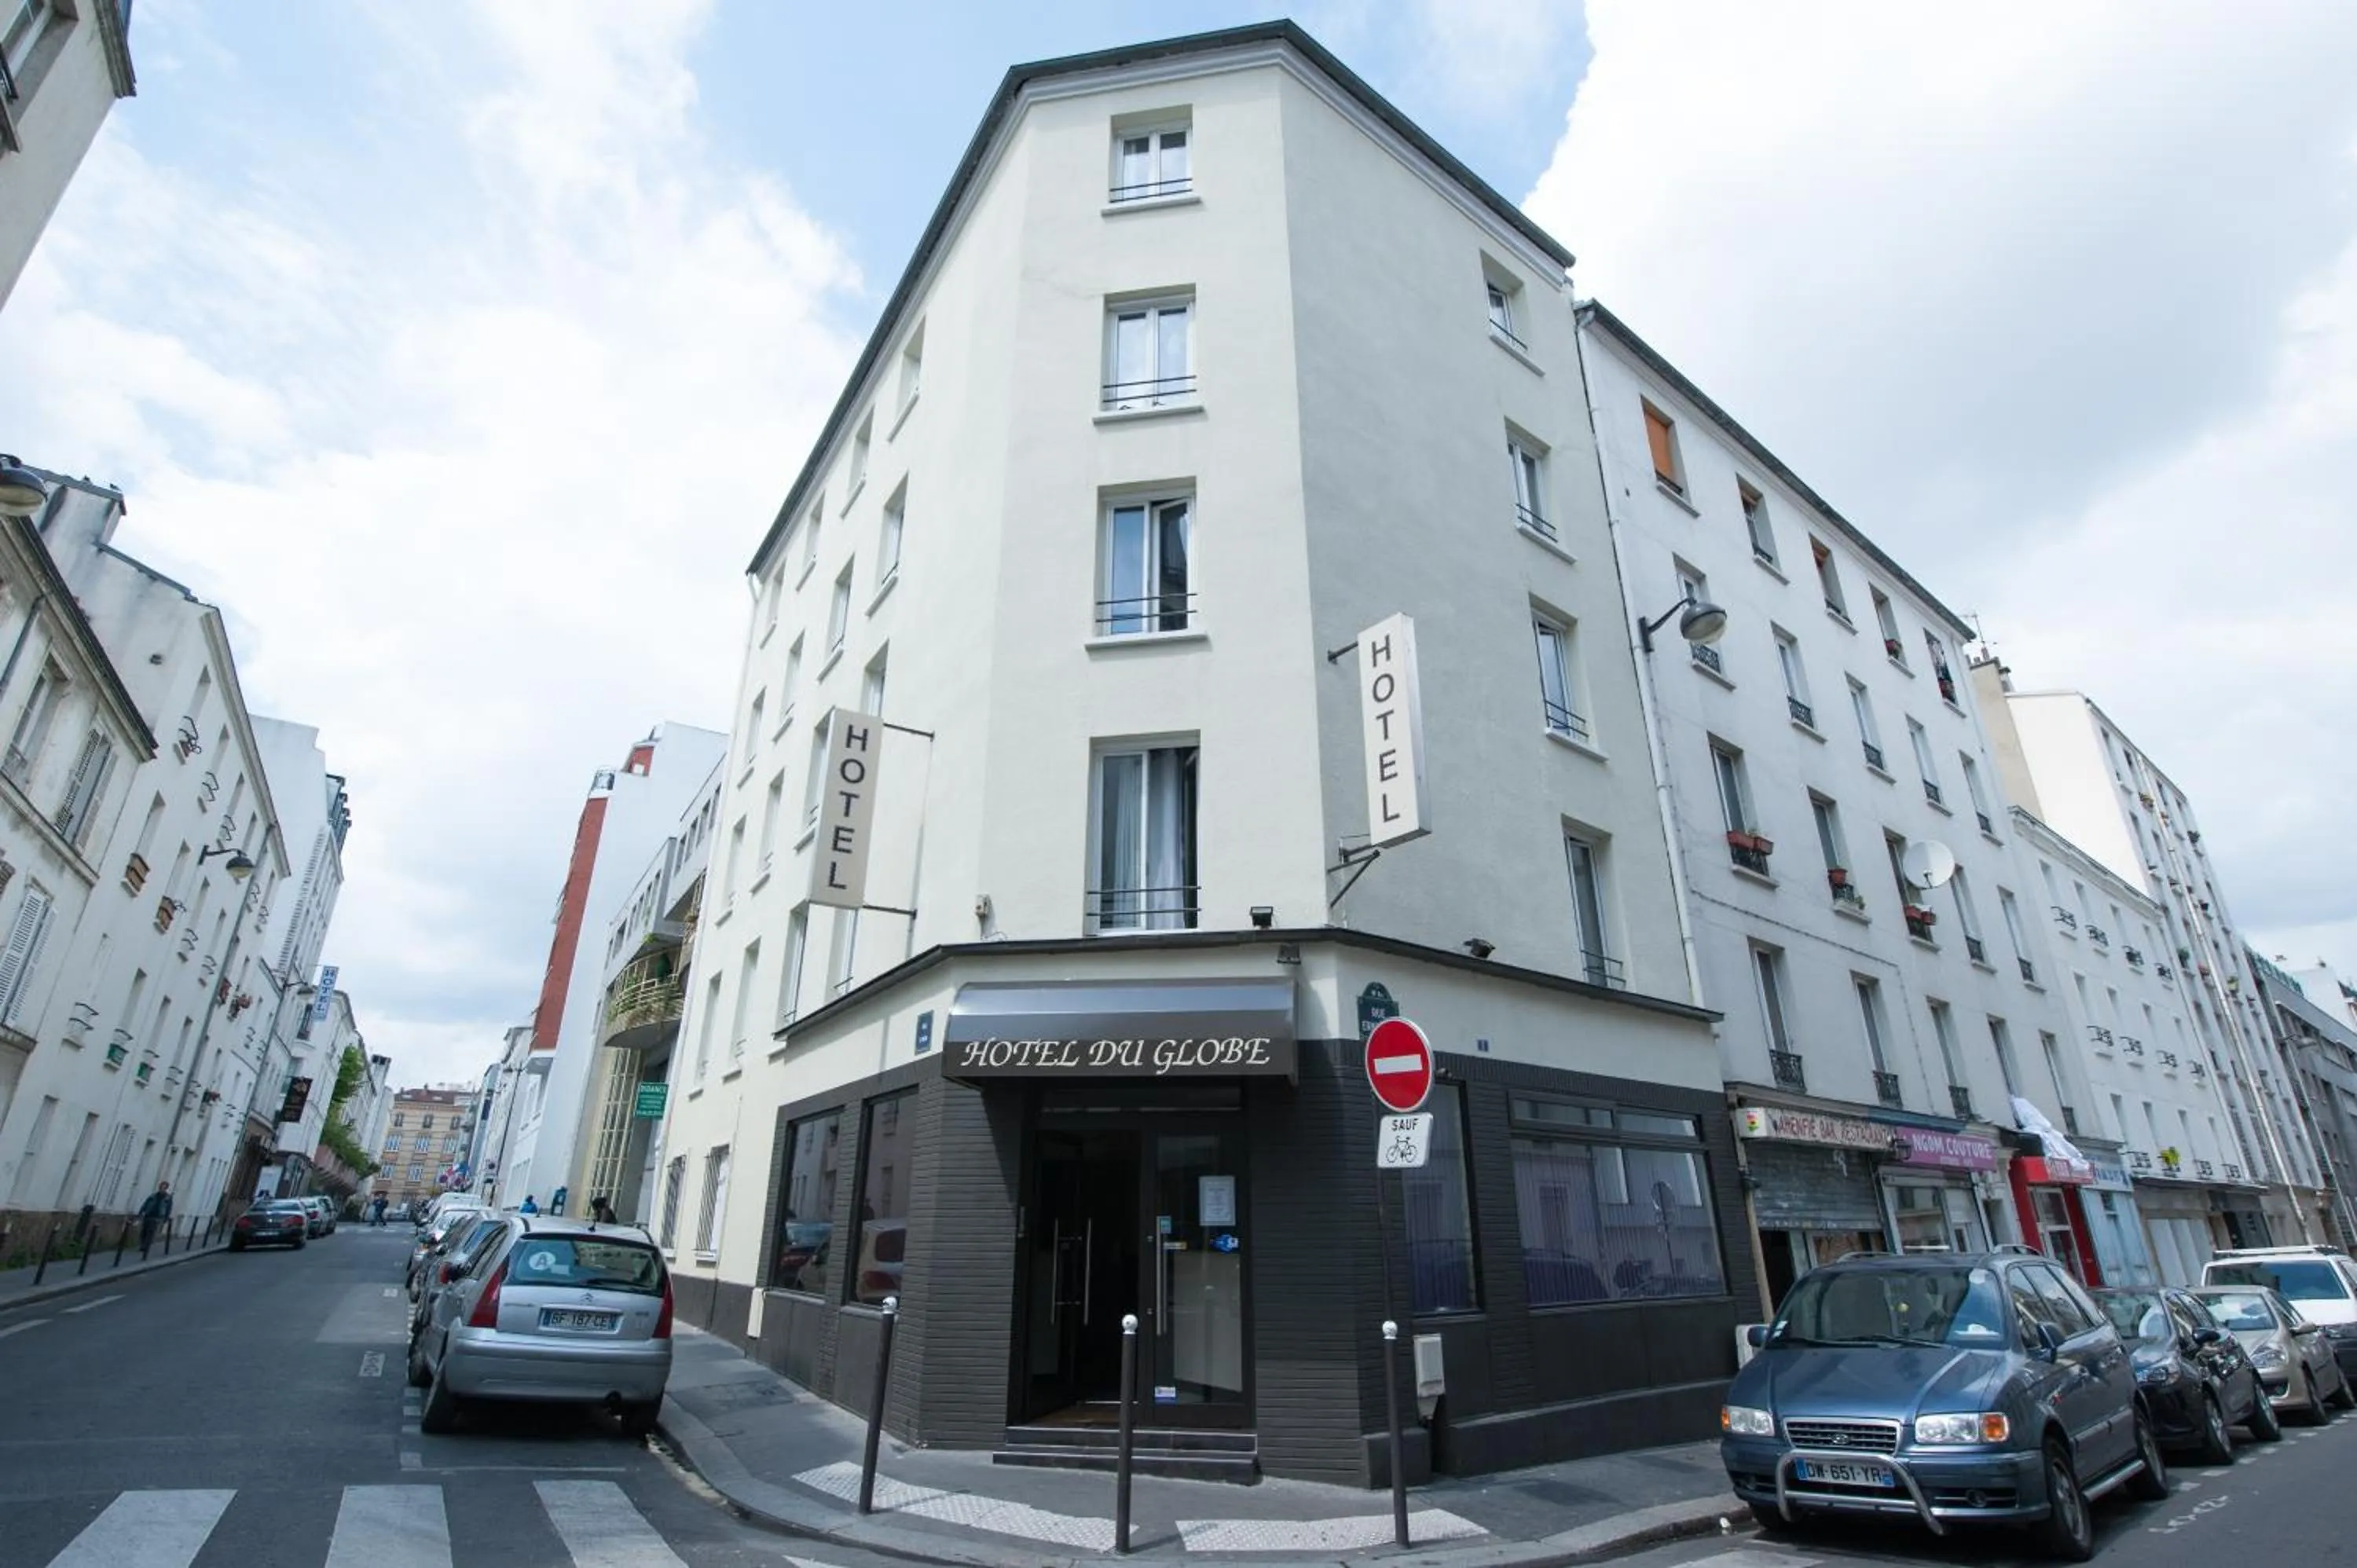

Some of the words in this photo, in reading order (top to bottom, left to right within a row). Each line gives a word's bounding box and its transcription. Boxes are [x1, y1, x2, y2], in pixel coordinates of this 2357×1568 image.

[1371, 633, 1401, 823] HOTEL
[828, 724, 869, 890] HOTEL
[316, 969, 335, 1012] HOTEL
[961, 1037, 1080, 1067] HOTEL
[1089, 1039, 1145, 1067] DU
[1153, 1038, 1270, 1075] GLOBE
[1391, 1118, 1418, 1131] SAUF
[1912, 1134, 1944, 1153] NGOM
[1946, 1137, 1993, 1160] COUTURE
